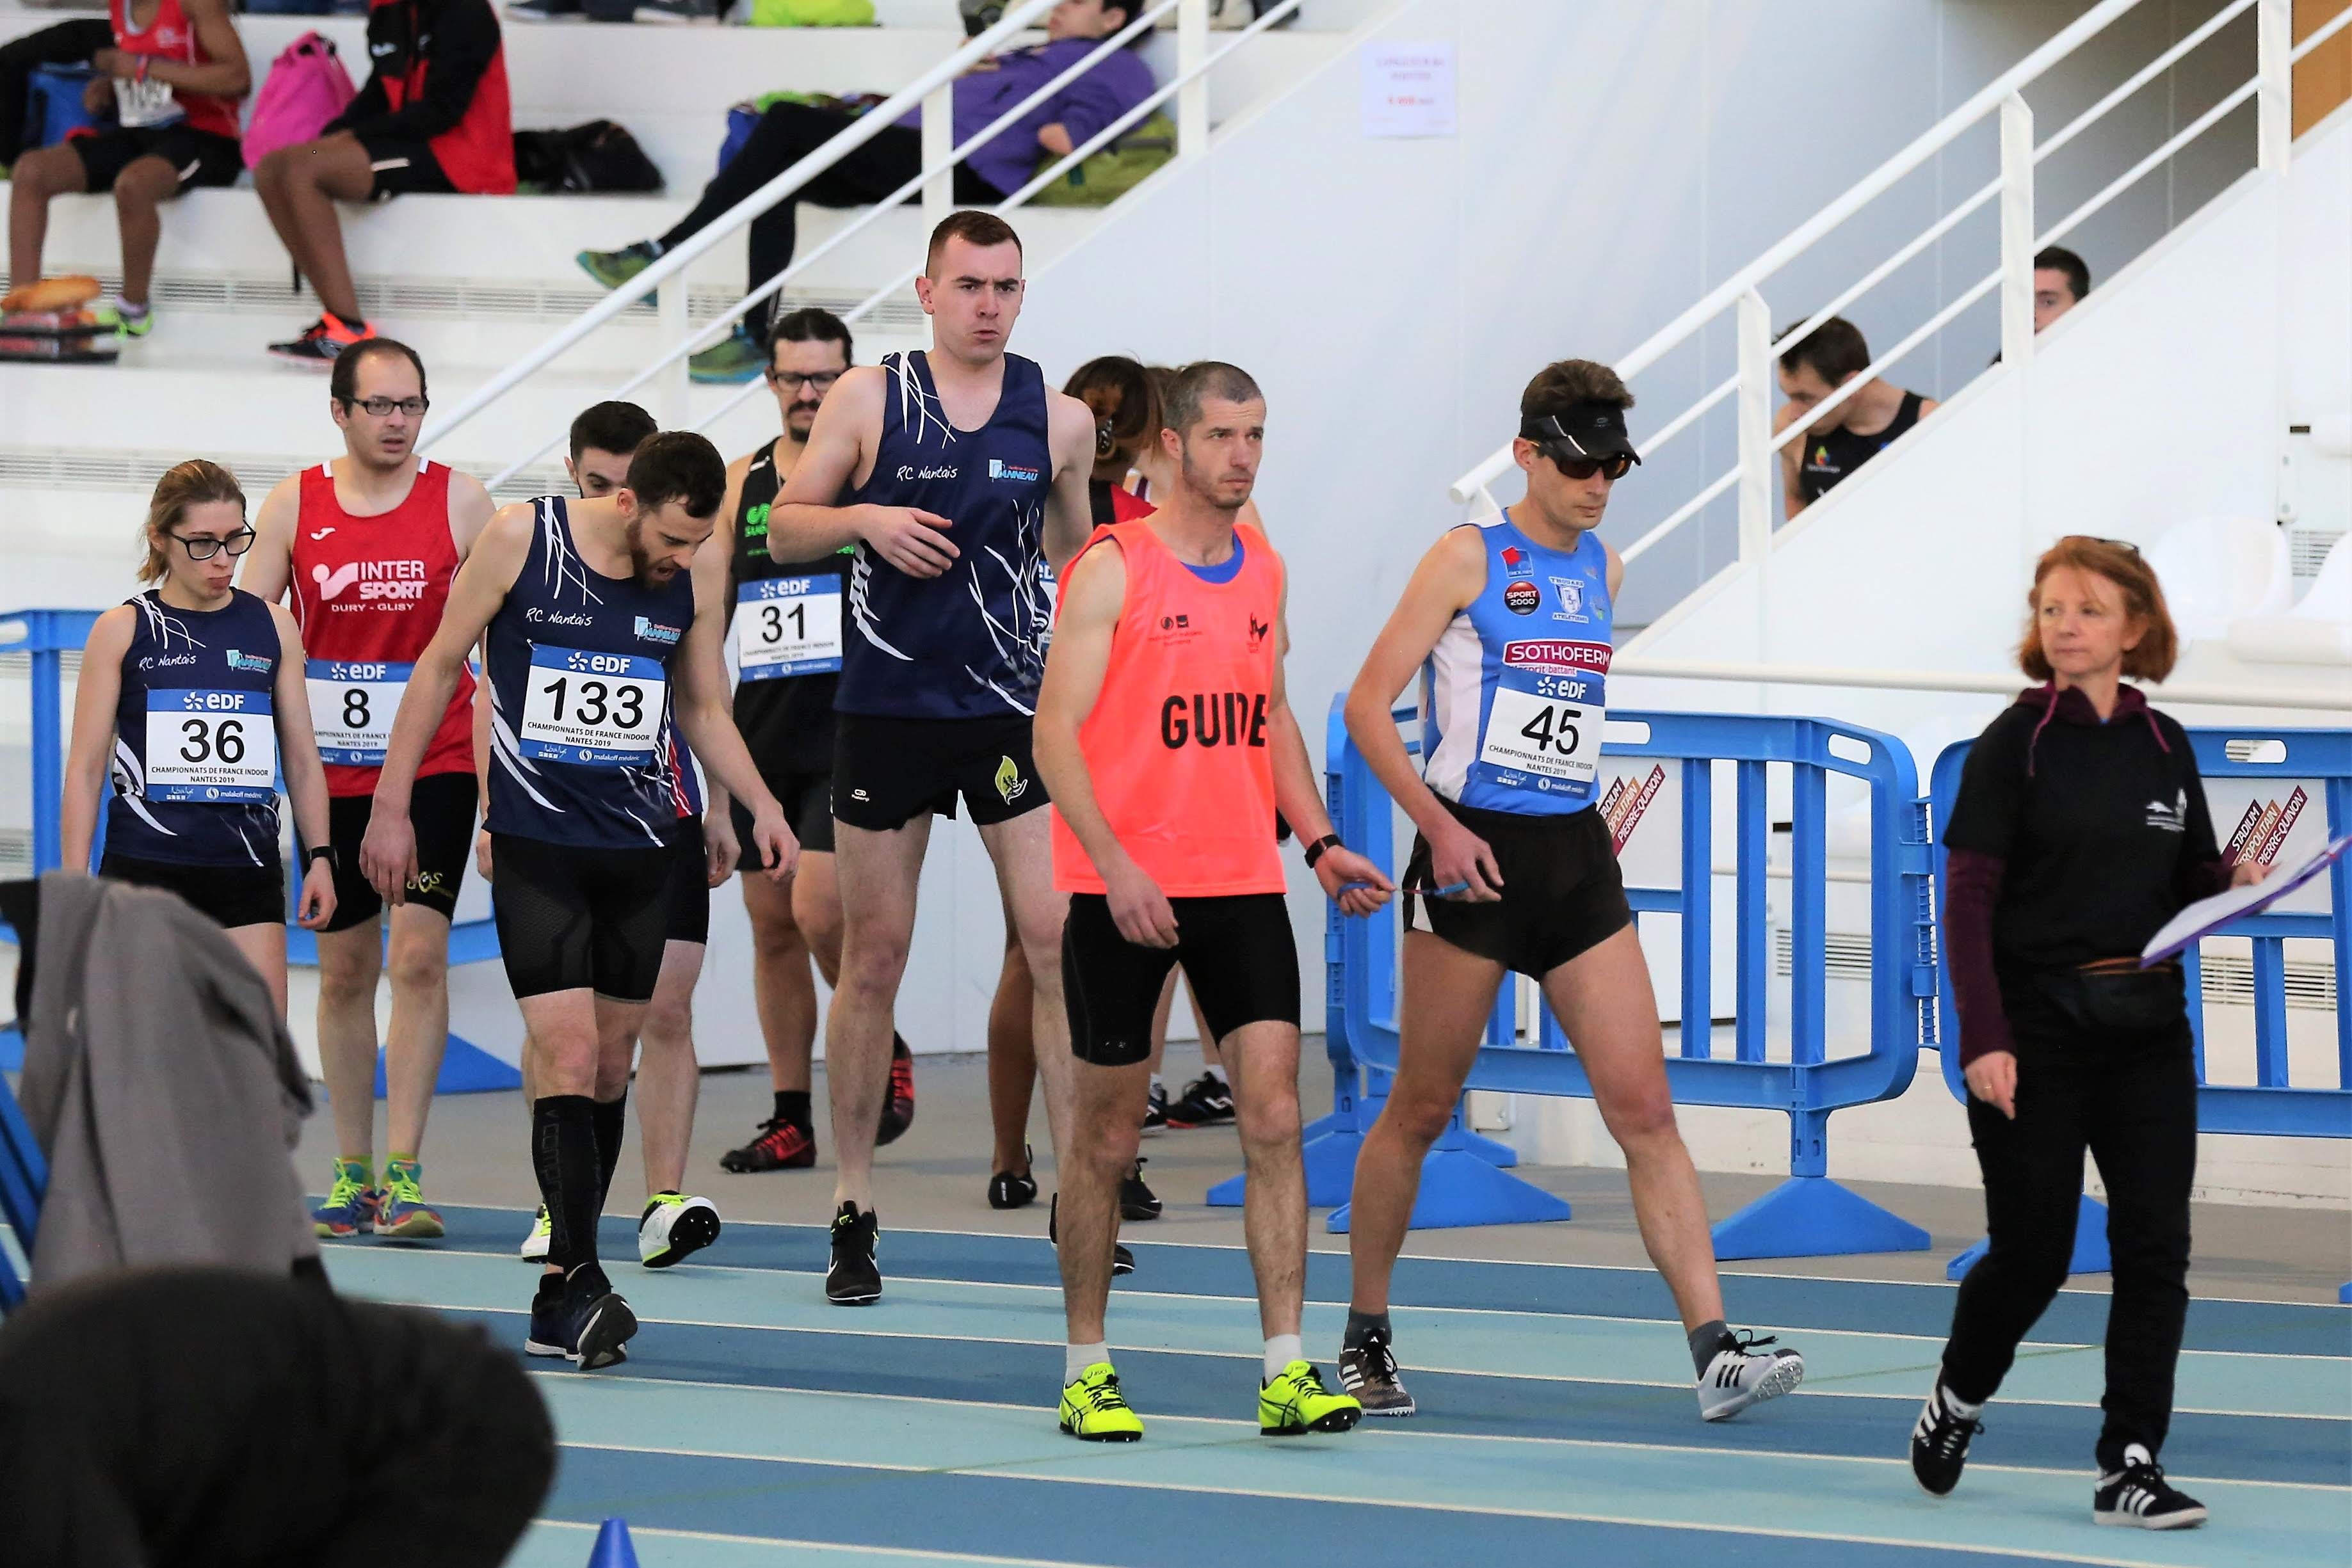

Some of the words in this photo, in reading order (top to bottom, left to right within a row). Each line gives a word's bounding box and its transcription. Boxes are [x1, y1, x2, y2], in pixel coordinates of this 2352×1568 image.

[897, 465, 914, 481] RC
[918, 465, 958, 480] Nantais
[361, 560, 425, 580] INTER
[359, 580, 426, 600] SPORT
[1506, 590, 1536, 599] SPORT
[332, 604, 366, 612] DURY
[377, 603, 415, 611] GLISY
[526, 608, 544, 622] RC
[548, 611, 593, 627] Nantais
[762, 604, 804, 643] 31
[139, 657, 154, 671] RC
[158, 653, 197, 667] Nantais
[342, 689, 370, 729] 8
[544, 677, 644, 729] 133
[181, 719, 245, 764] 36
[528, 722, 583, 735] CHAMPIONNATS
[595, 730, 622, 739] FRANCE
[565, 737, 593, 746] NANTES
[1521, 705, 1581, 755] 45
[1489, 745, 1545, 762] CHAMPIONNATS
[1555, 758, 1575, 767] FRANCE
[1527, 764, 1552, 774] NANTES
[1600, 783, 1622, 819] TADIUM
[1607, 783, 1638, 833] OPOLITAIN
[1618, 770, 1663, 843] PIERRE-QUINON
[2232, 806, 2260, 852] STADIUM
[2237, 806, 2278, 864] ROPOLITAIN
[2257, 792, 2304, 866] PIERRE-QUINON
